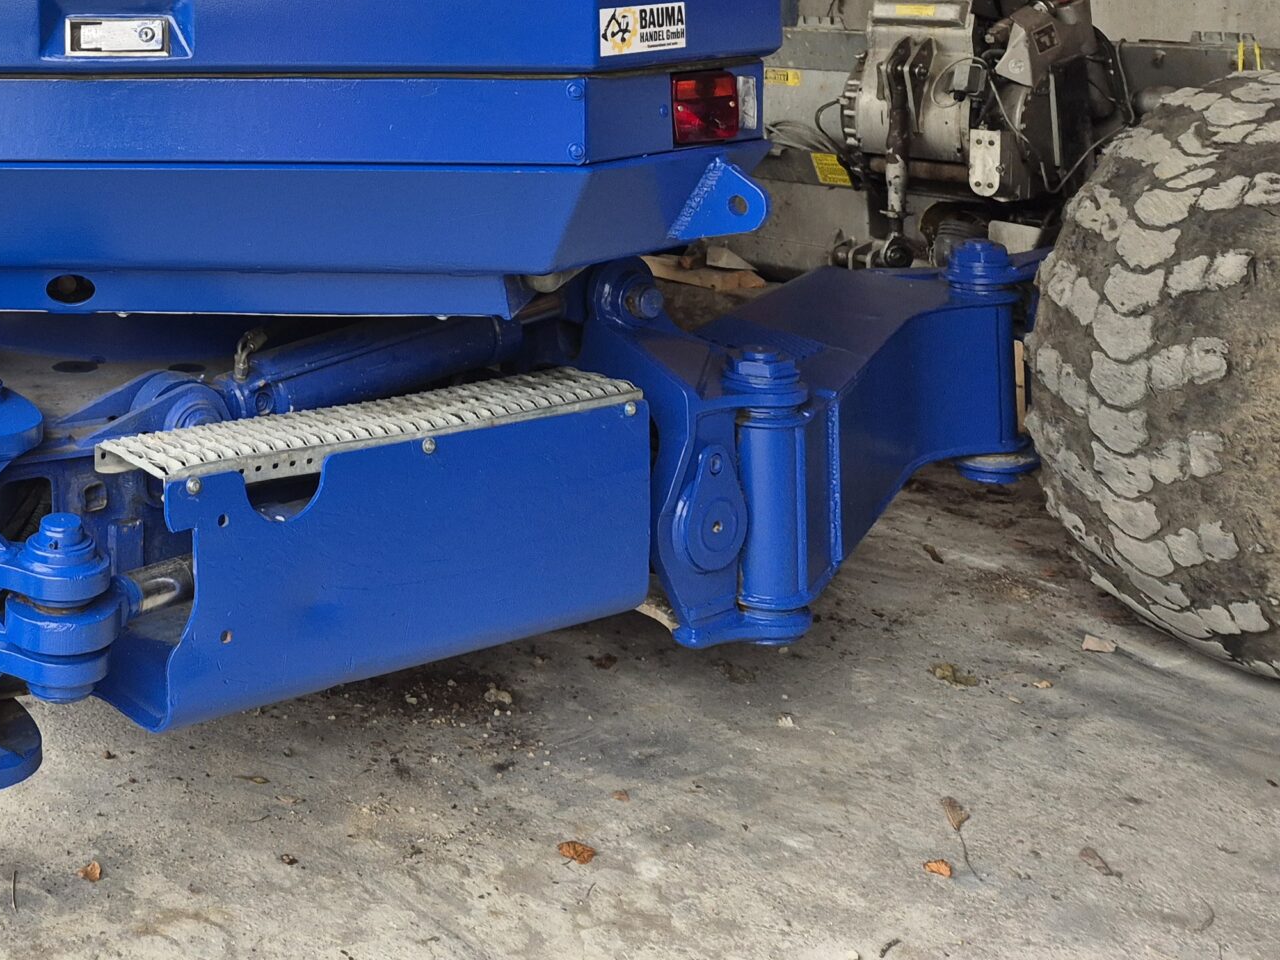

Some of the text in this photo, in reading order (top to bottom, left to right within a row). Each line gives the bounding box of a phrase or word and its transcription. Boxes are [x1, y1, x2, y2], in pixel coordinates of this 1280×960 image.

[639, 5, 684, 29] BAUMA
[639, 28, 685, 43] HANDEL GmbH
